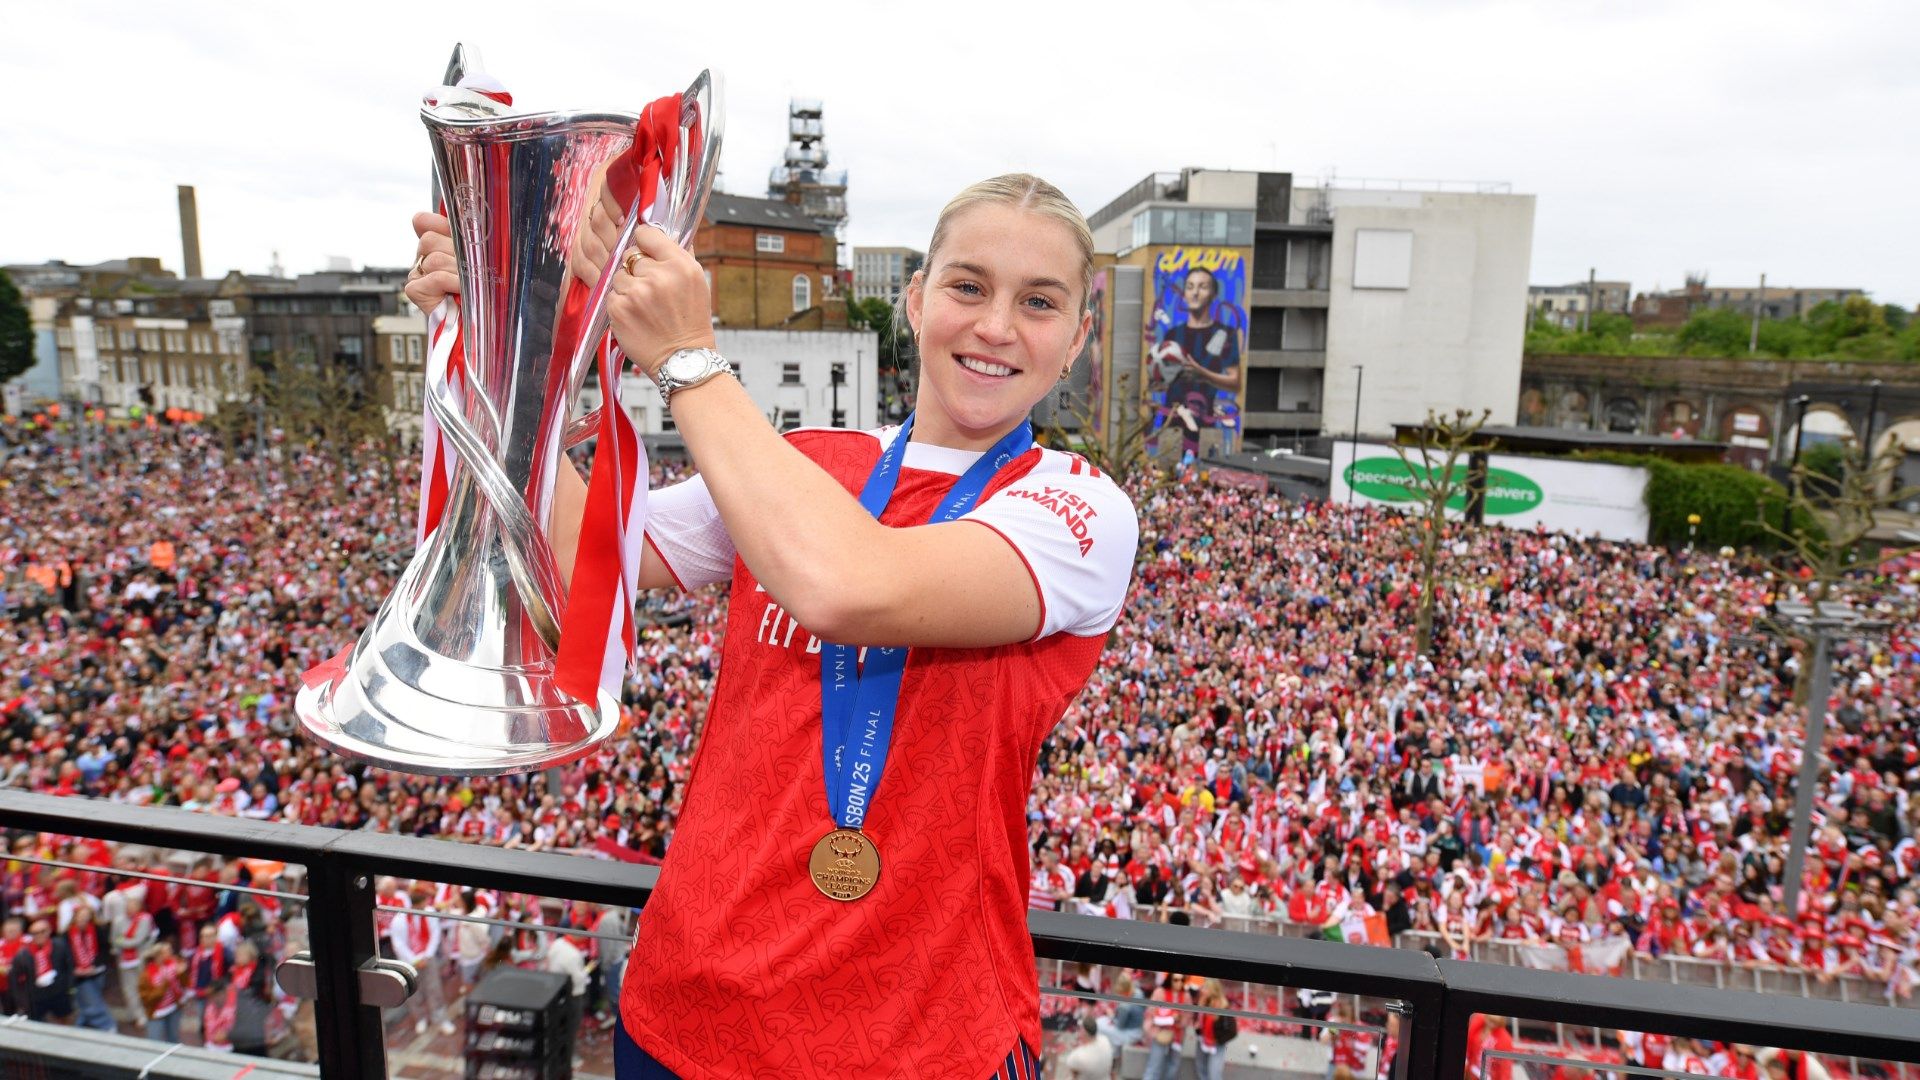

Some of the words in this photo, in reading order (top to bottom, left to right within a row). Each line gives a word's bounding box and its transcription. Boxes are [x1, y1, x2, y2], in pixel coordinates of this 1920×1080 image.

[944, 492, 976, 520] FINAL
[1044, 486, 1098, 521] VISIT
[757, 602, 798, 648] FLY
[835, 644, 846, 691] FINAL
[860, 709, 881, 757] FINAL
[852, 761, 871, 784] 25
[844, 782, 867, 829] ISBON
[815, 871, 871, 886] CHAMPIONS
[824, 881, 861, 892] LEAGUE
